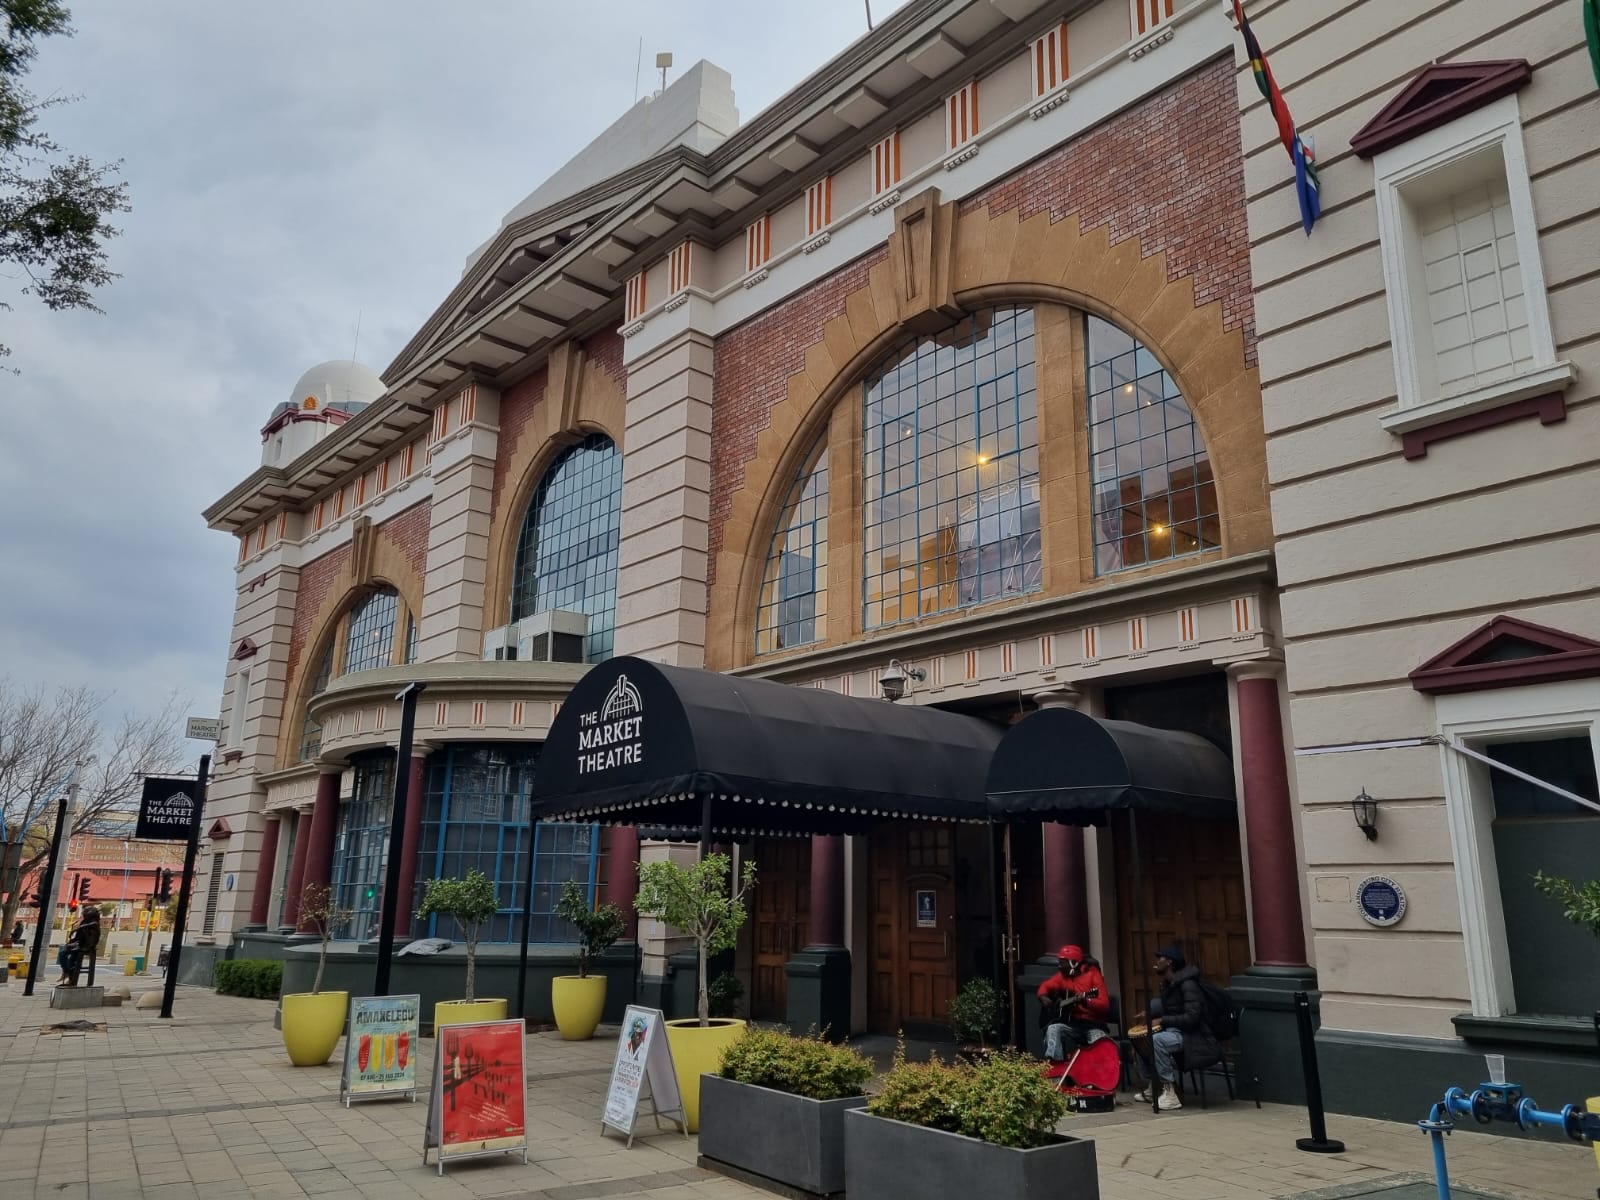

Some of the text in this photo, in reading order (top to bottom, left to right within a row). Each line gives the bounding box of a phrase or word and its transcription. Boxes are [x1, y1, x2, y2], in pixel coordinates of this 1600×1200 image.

[580, 711, 598, 727] THE
[578, 716, 643, 751] MARKET
[578, 743, 642, 774] THEATRE
[147, 806, 194, 816] MARKET
[146, 815, 193, 825] THEATRE
